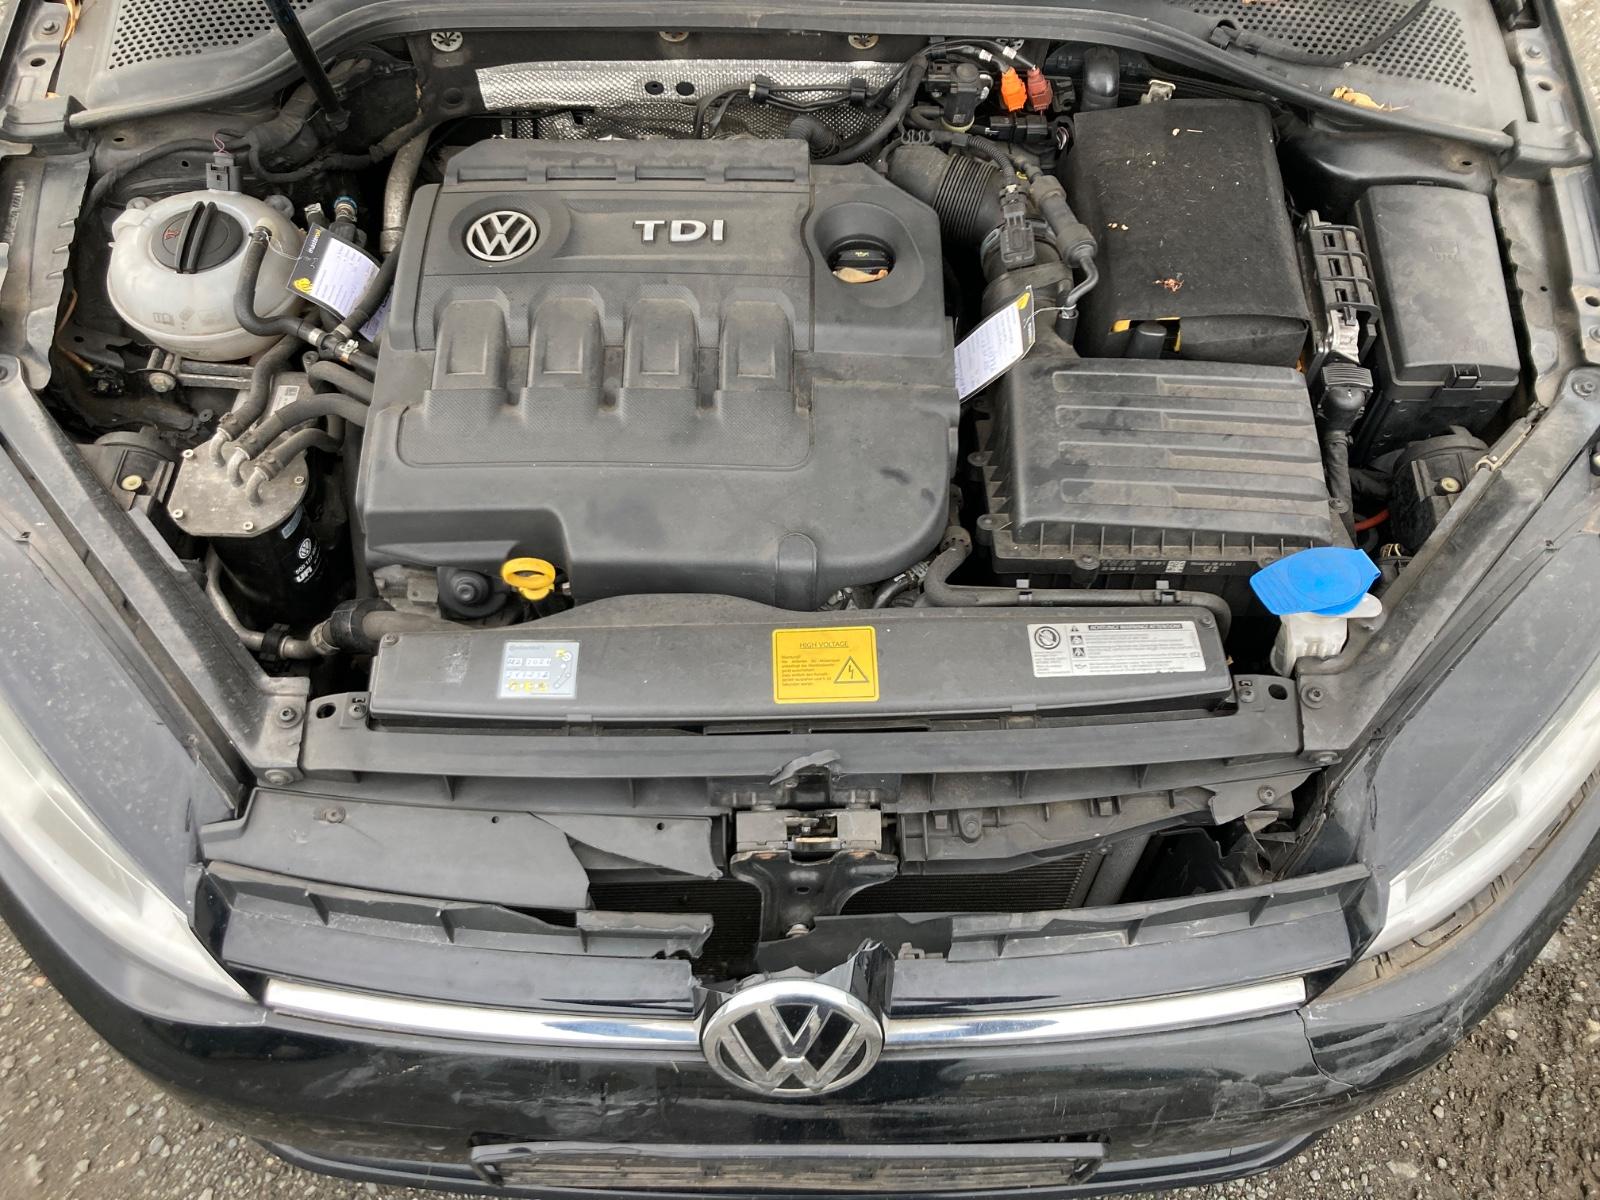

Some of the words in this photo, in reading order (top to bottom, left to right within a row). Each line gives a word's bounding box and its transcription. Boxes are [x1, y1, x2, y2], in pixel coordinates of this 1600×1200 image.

[634, 219, 724, 242] TDI
[799, 641, 816, 649] HIGH
[817, 640, 849, 649] VOLTAGE
